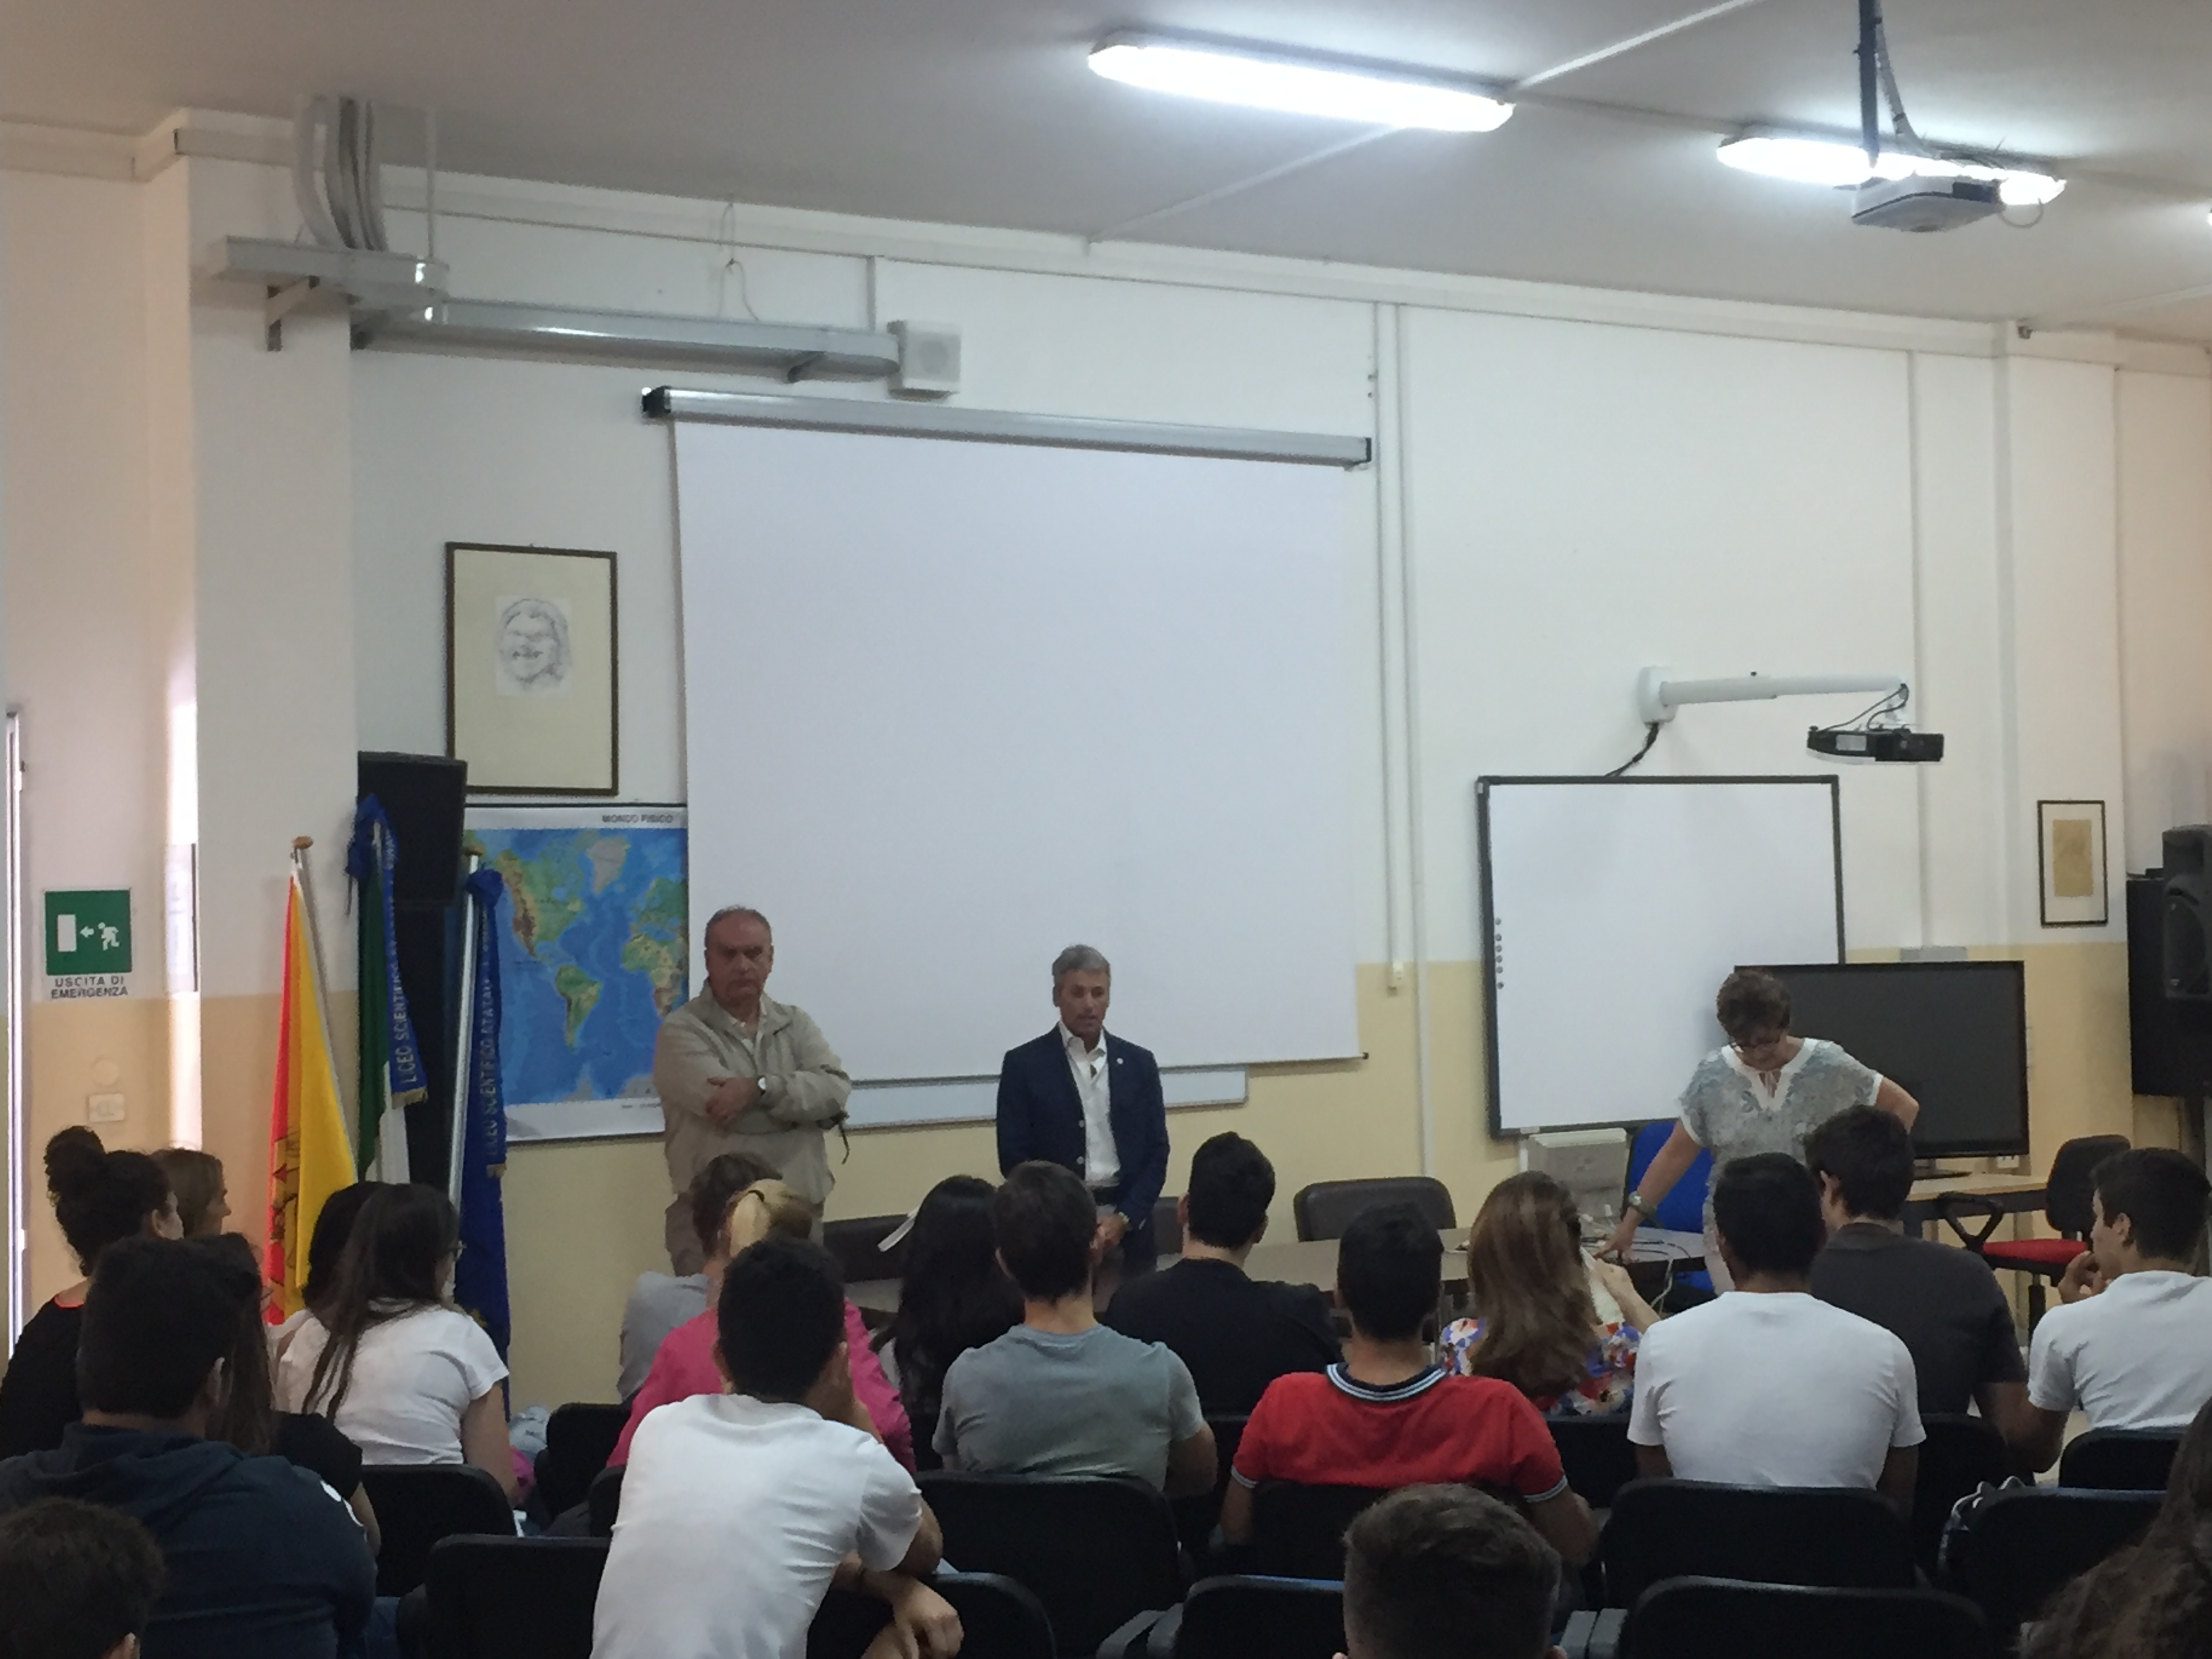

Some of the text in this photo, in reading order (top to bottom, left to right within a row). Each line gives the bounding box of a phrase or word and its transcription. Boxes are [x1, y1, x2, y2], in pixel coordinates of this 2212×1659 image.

[54, 975, 124, 987] USCITA DI
[51, 986, 129, 999] EMERGENZA
[394, 1046, 418, 1084] LICEO
